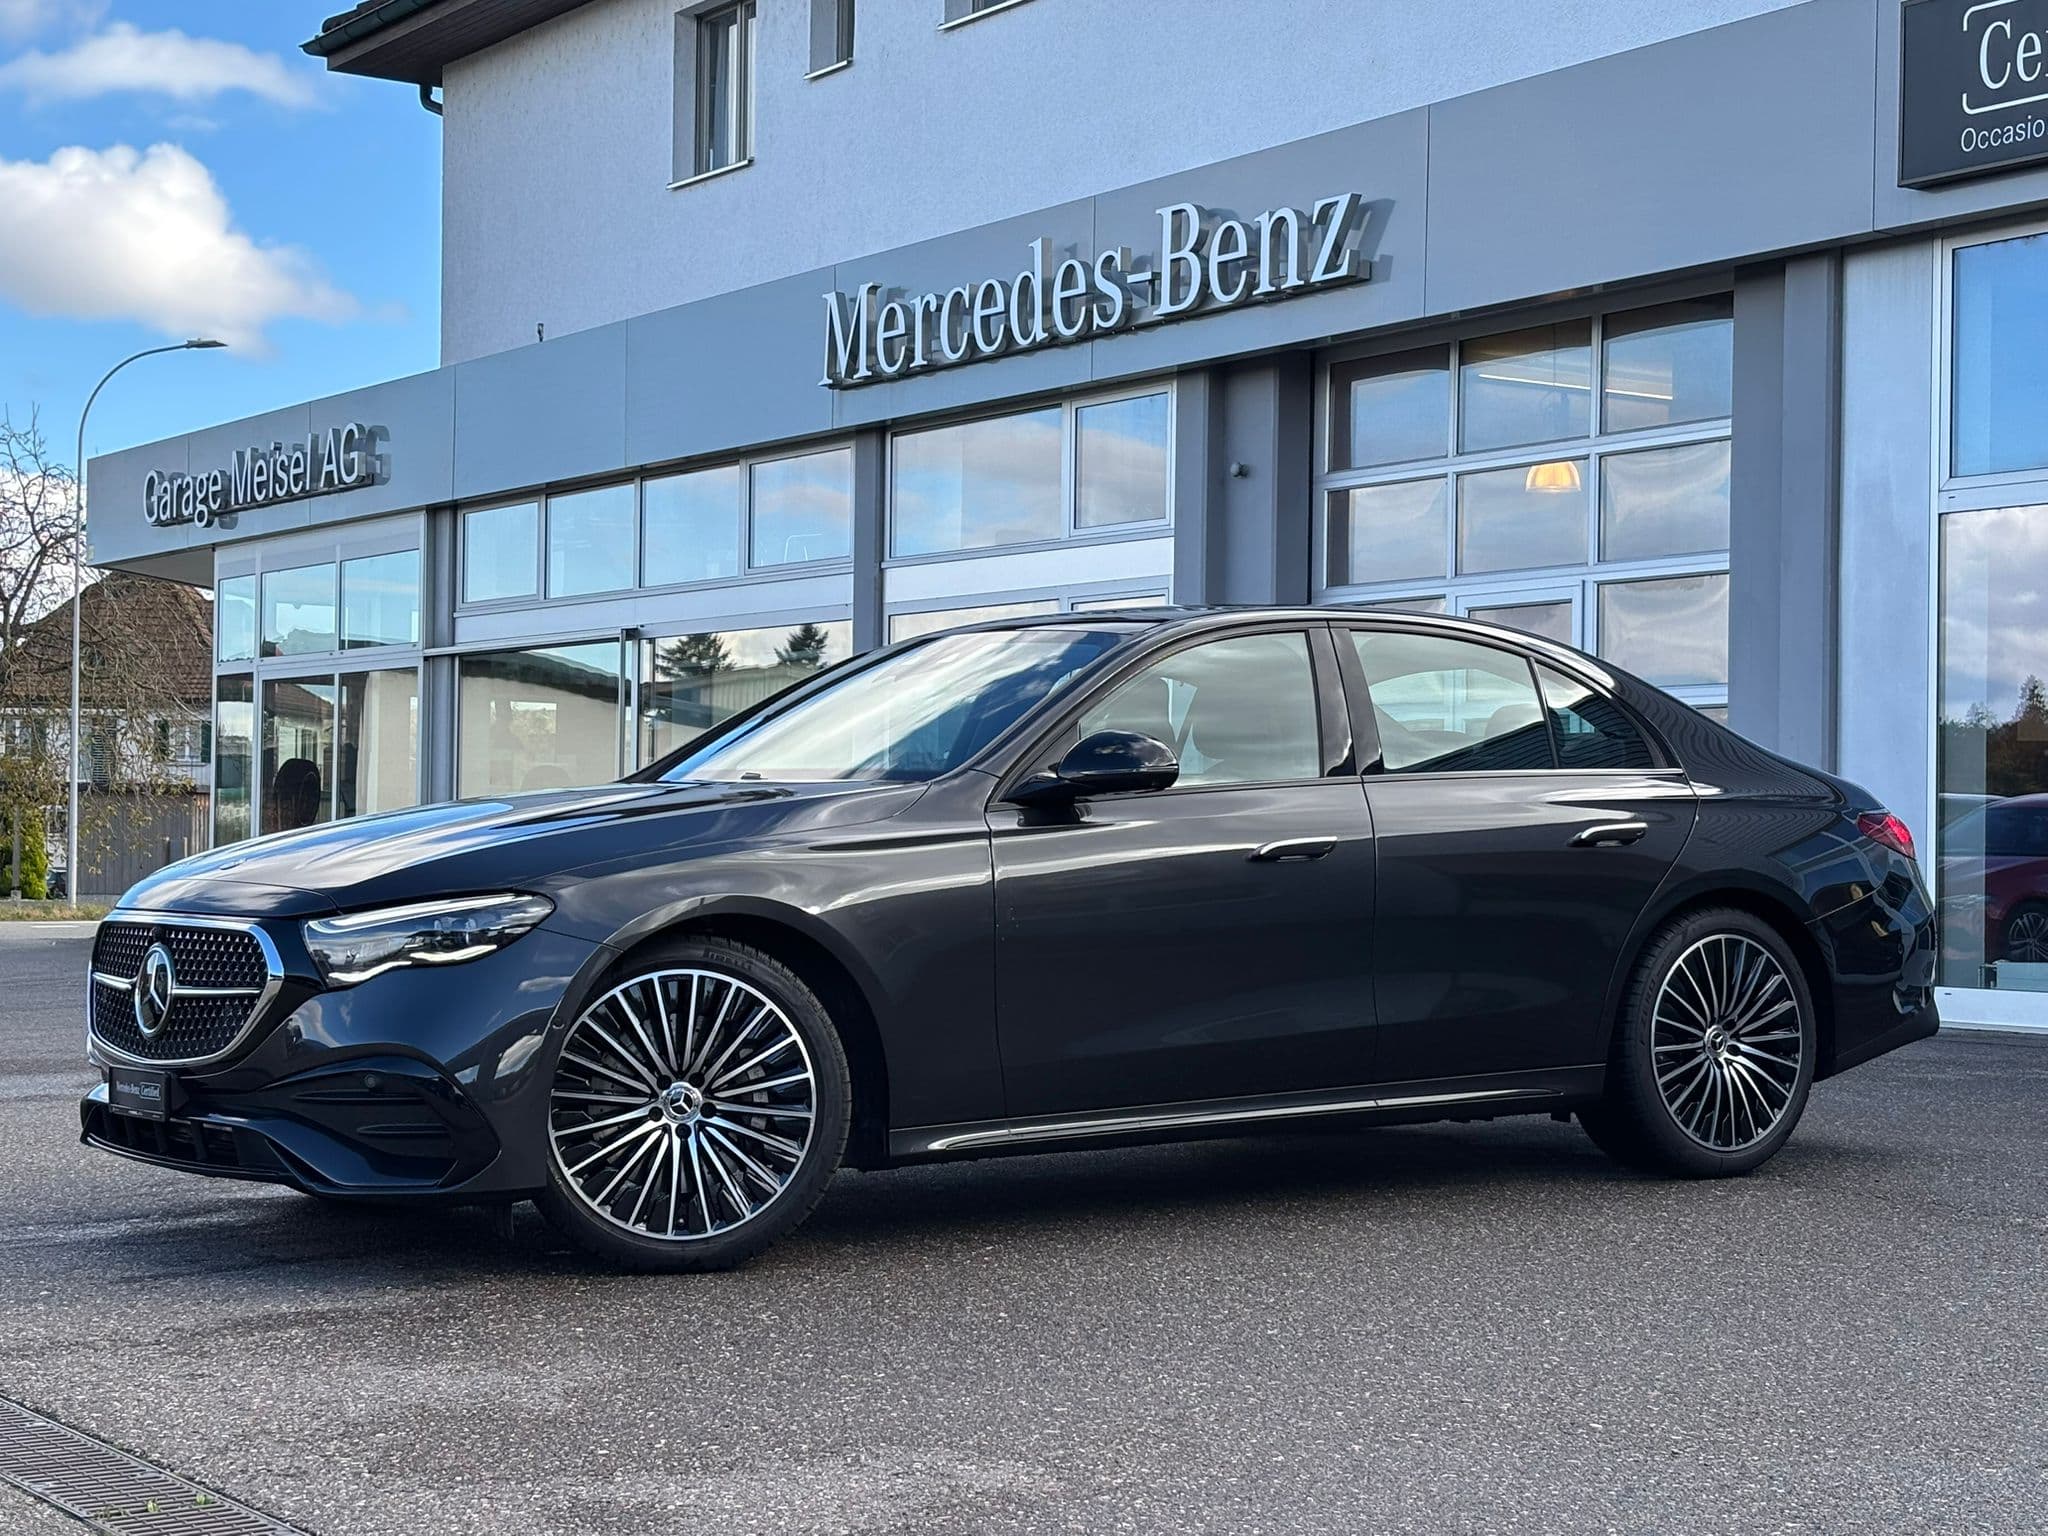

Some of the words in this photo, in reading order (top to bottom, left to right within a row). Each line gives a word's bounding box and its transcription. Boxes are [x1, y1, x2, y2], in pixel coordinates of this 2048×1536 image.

[1979, 18, 2048, 90] Ce
[1960, 115, 2048, 152] Occasio
[818, 191, 1364, 388] Mercedes-Benz
[143, 469, 222, 529] Garage
[230, 432, 316, 506] Meisel
[319, 422, 362, 488] AG
